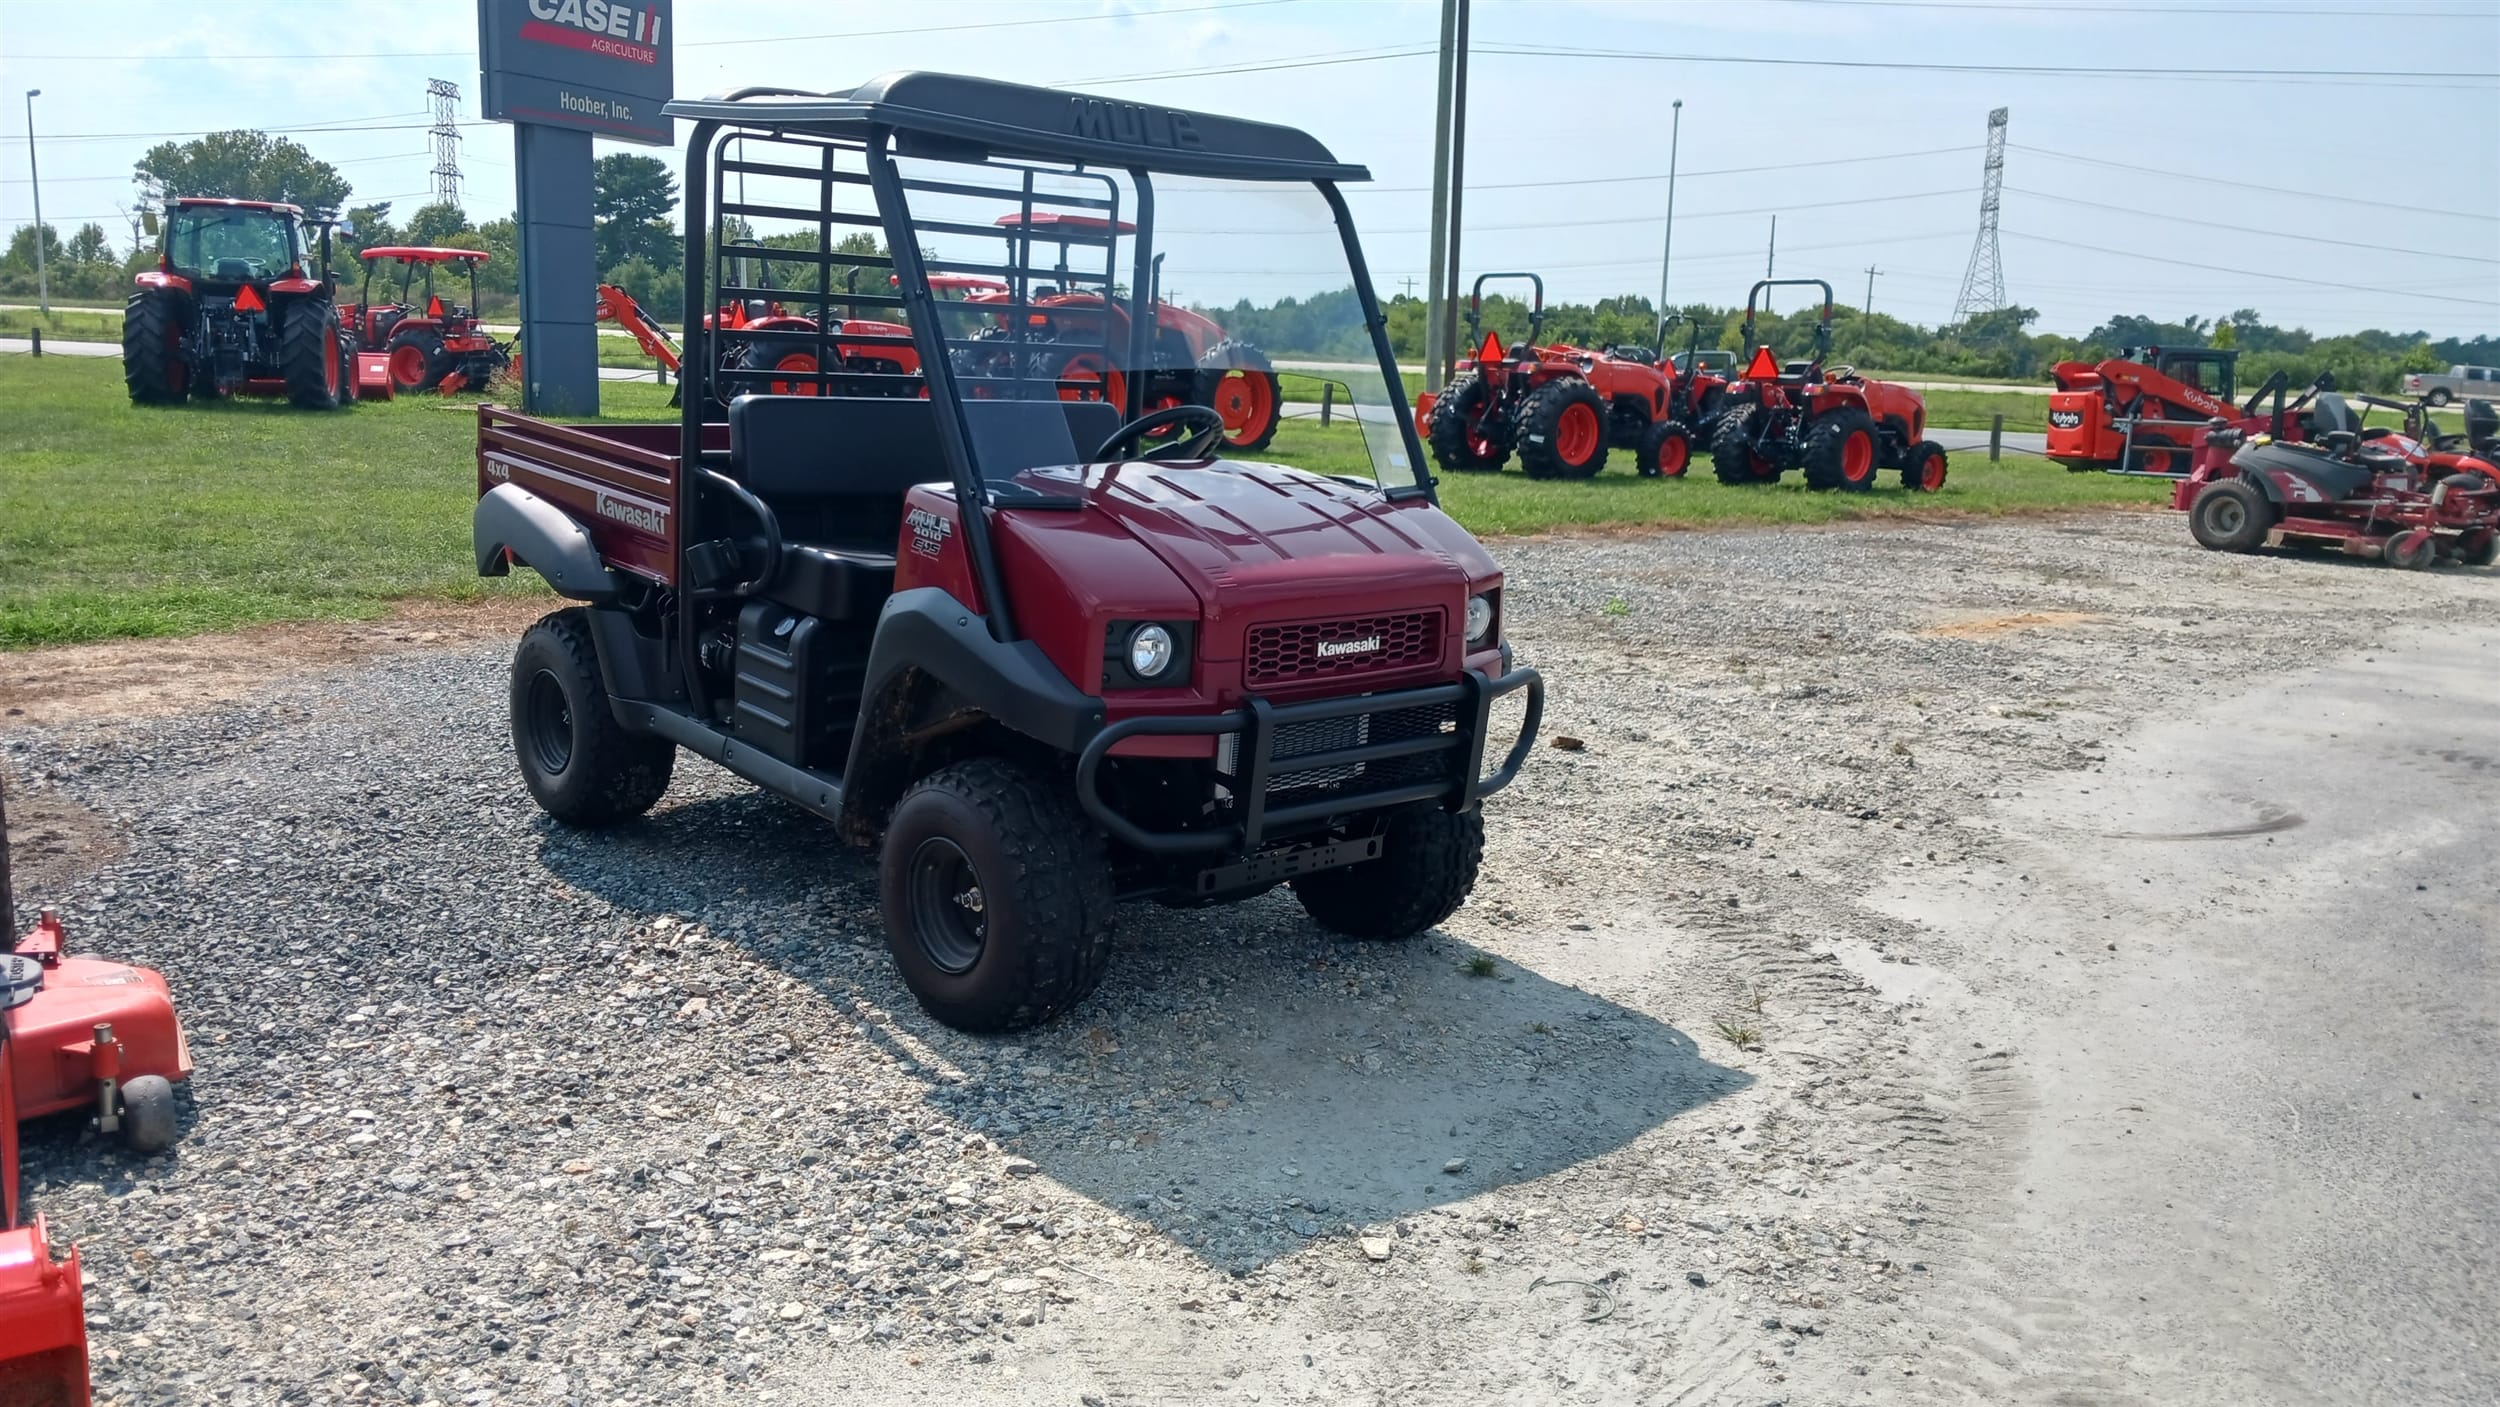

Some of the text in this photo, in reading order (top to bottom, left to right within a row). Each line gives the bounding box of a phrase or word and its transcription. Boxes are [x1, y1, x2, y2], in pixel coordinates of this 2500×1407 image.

[528, 0, 631, 38] CASE
[591, 39, 654, 64] AGRICULTURE
[560, 91, 633, 121] Hoober, Inc.
[1070, 97, 1206, 151] MULE
[2052, 412, 2079, 425] Kubota
[487, 460, 510, 480] 4x4
[596, 491, 665, 535] Kawasaki
[905, 508, 951, 537] MULE
[913, 527, 942, 541] 4010
[1317, 635, 1380, 658] Kawasaki
